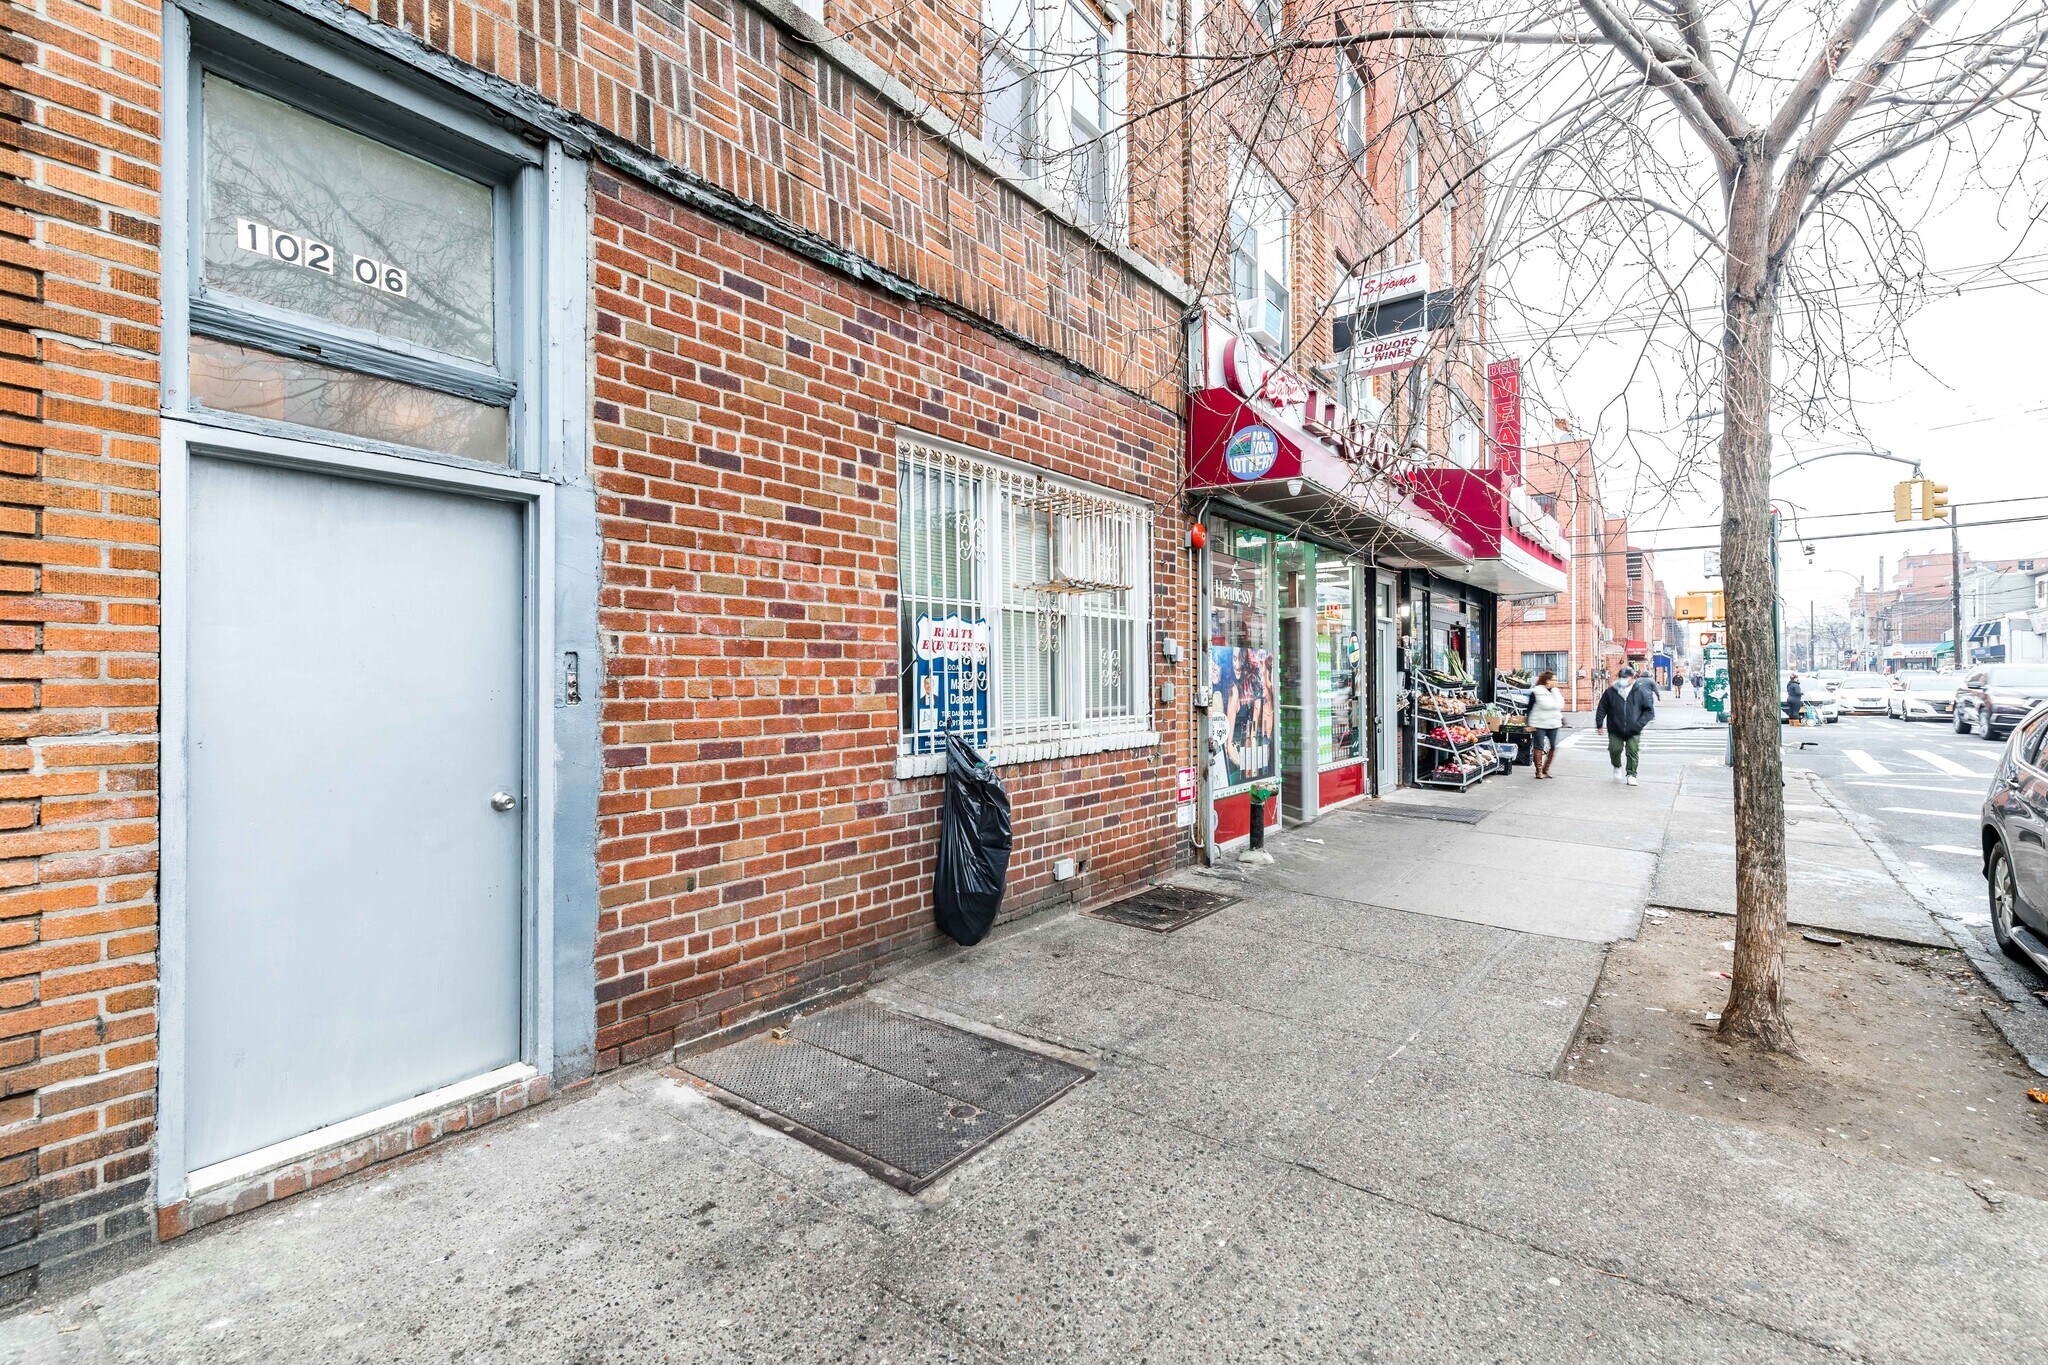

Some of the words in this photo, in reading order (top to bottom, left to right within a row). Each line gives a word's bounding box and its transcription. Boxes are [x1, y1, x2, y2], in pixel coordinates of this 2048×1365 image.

[247, 223, 331, 273] 102
[354, 257, 404, 293] 06
[1364, 337, 1417, 356] LIQUORS
[1374, 347, 1412, 362] WINES
[1492, 375, 1518, 473] MEAT
[1252, 431, 1271, 441] NEW
[1252, 441, 1274, 454] YORK
[1229, 454, 1275, 474] LOTTERY
[1215, 579, 1254, 608] Hennessy
